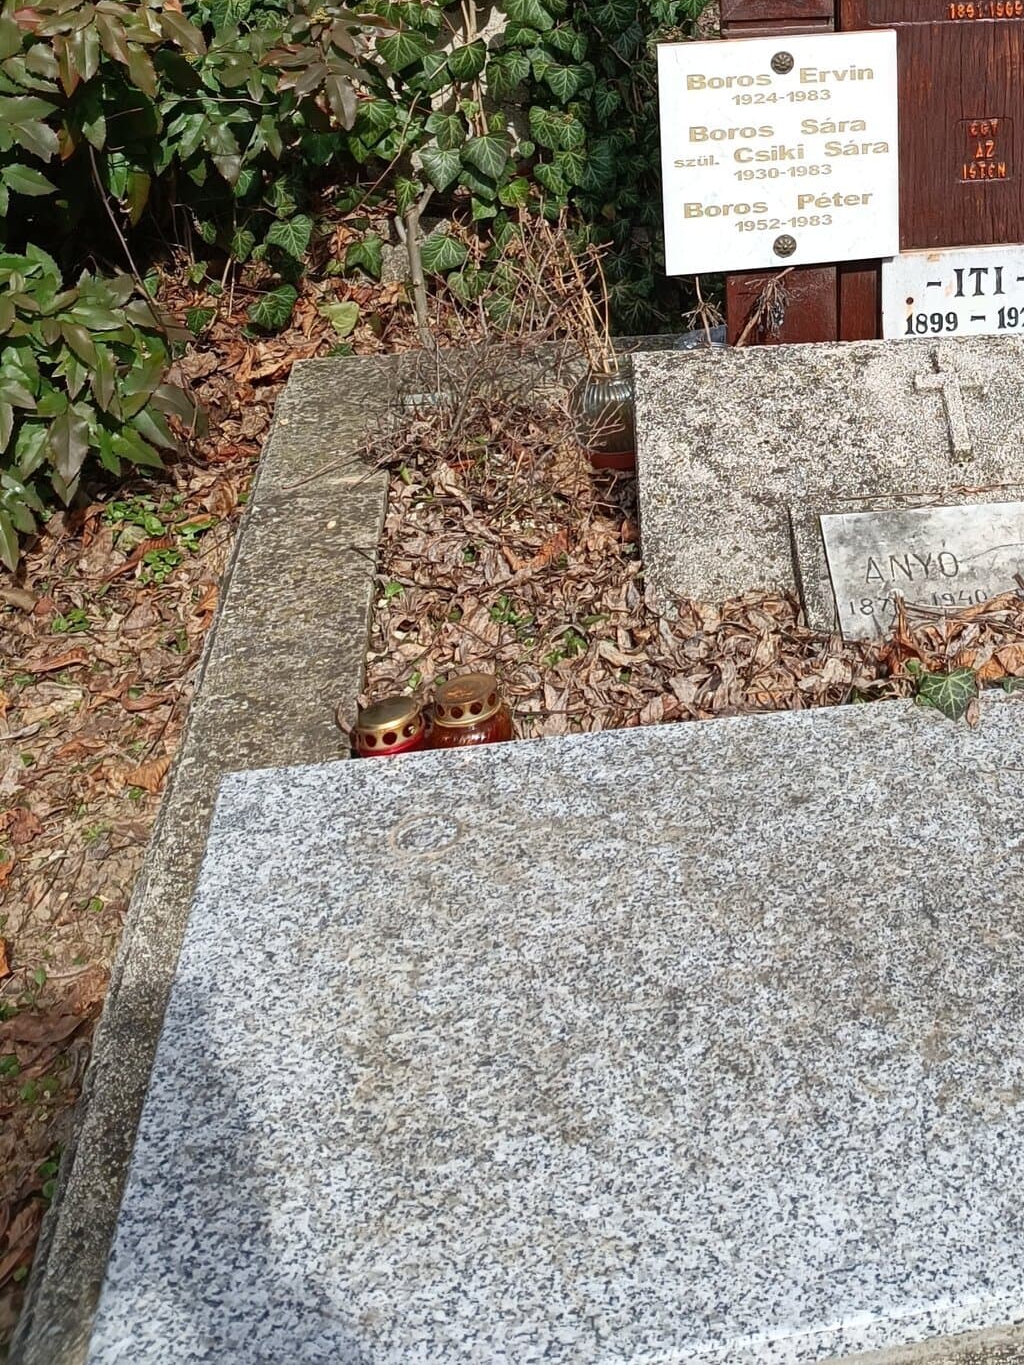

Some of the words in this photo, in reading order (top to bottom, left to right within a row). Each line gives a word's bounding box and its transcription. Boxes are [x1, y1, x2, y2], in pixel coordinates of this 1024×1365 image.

[686, 73, 772, 91] Boros
[799, 65, 874, 84] Ervin
[731, 89, 831, 106] 1924-1983
[688, 125, 775, 142] Boros
[800, 117, 866, 135] Sára
[673, 154, 720, 168] szül.
[733, 144, 805, 163] Csiki
[824, 139, 890, 157] Sára
[976, 140, 993, 158] AZ
[734, 164, 833, 181] 1930-1983
[963, 161, 1005, 179] ISTEN
[683, 201, 768, 219] Boros
[797, 192, 873, 210] Péter
[735, 214, 833, 233] 1952-1983
[953, 266, 1007, 297] ITI
[905, 312, 958, 335] 1899
